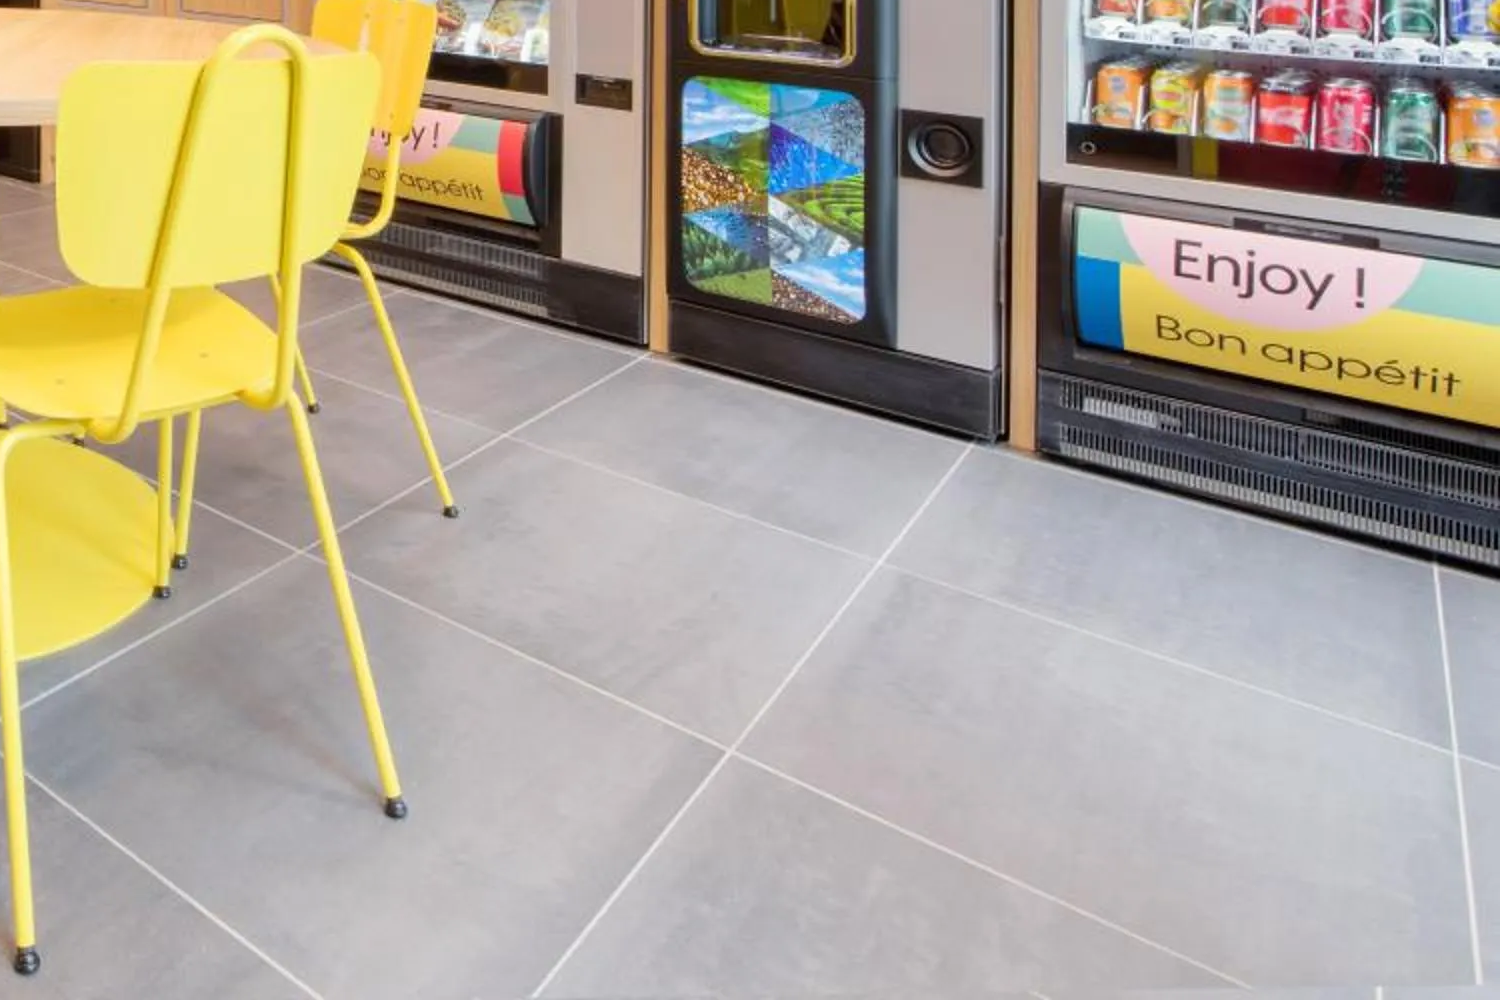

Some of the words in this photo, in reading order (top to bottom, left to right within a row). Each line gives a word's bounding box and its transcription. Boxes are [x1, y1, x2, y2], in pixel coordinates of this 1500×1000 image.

[400, 173, 484, 201] appétit
[1173, 239, 1334, 311] Enjoy
[1155, 314, 1247, 355] Bon
[1260, 343, 1462, 398] appétit
